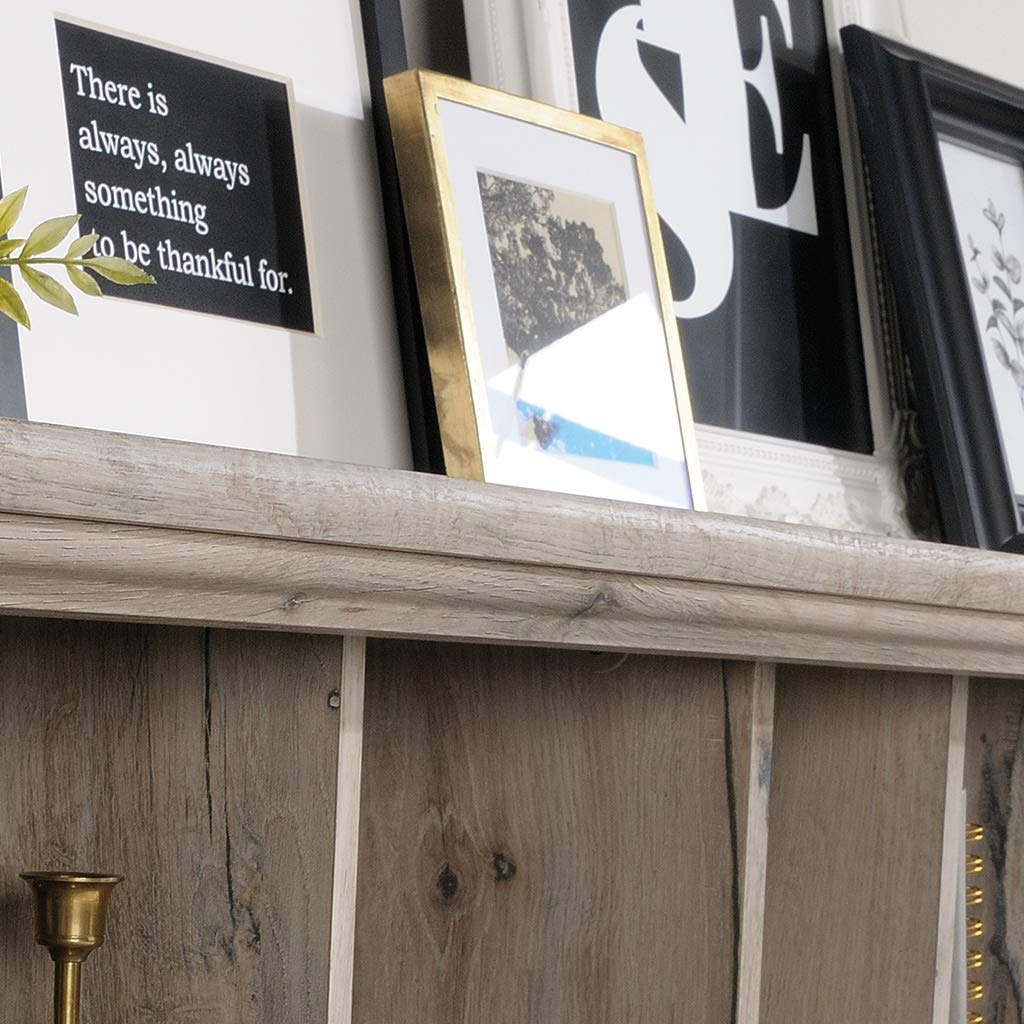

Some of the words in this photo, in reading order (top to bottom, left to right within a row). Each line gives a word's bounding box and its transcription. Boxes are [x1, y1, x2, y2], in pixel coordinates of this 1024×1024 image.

[69, 62, 141, 110] There
[147, 82, 169, 117] is
[78, 120, 167, 173] always,
[174, 142, 250, 190] always
[84, 179, 209, 235] something
[120, 230, 152, 266] be
[157, 239, 255, 287] thankful
[258, 258, 294, 295] for.
